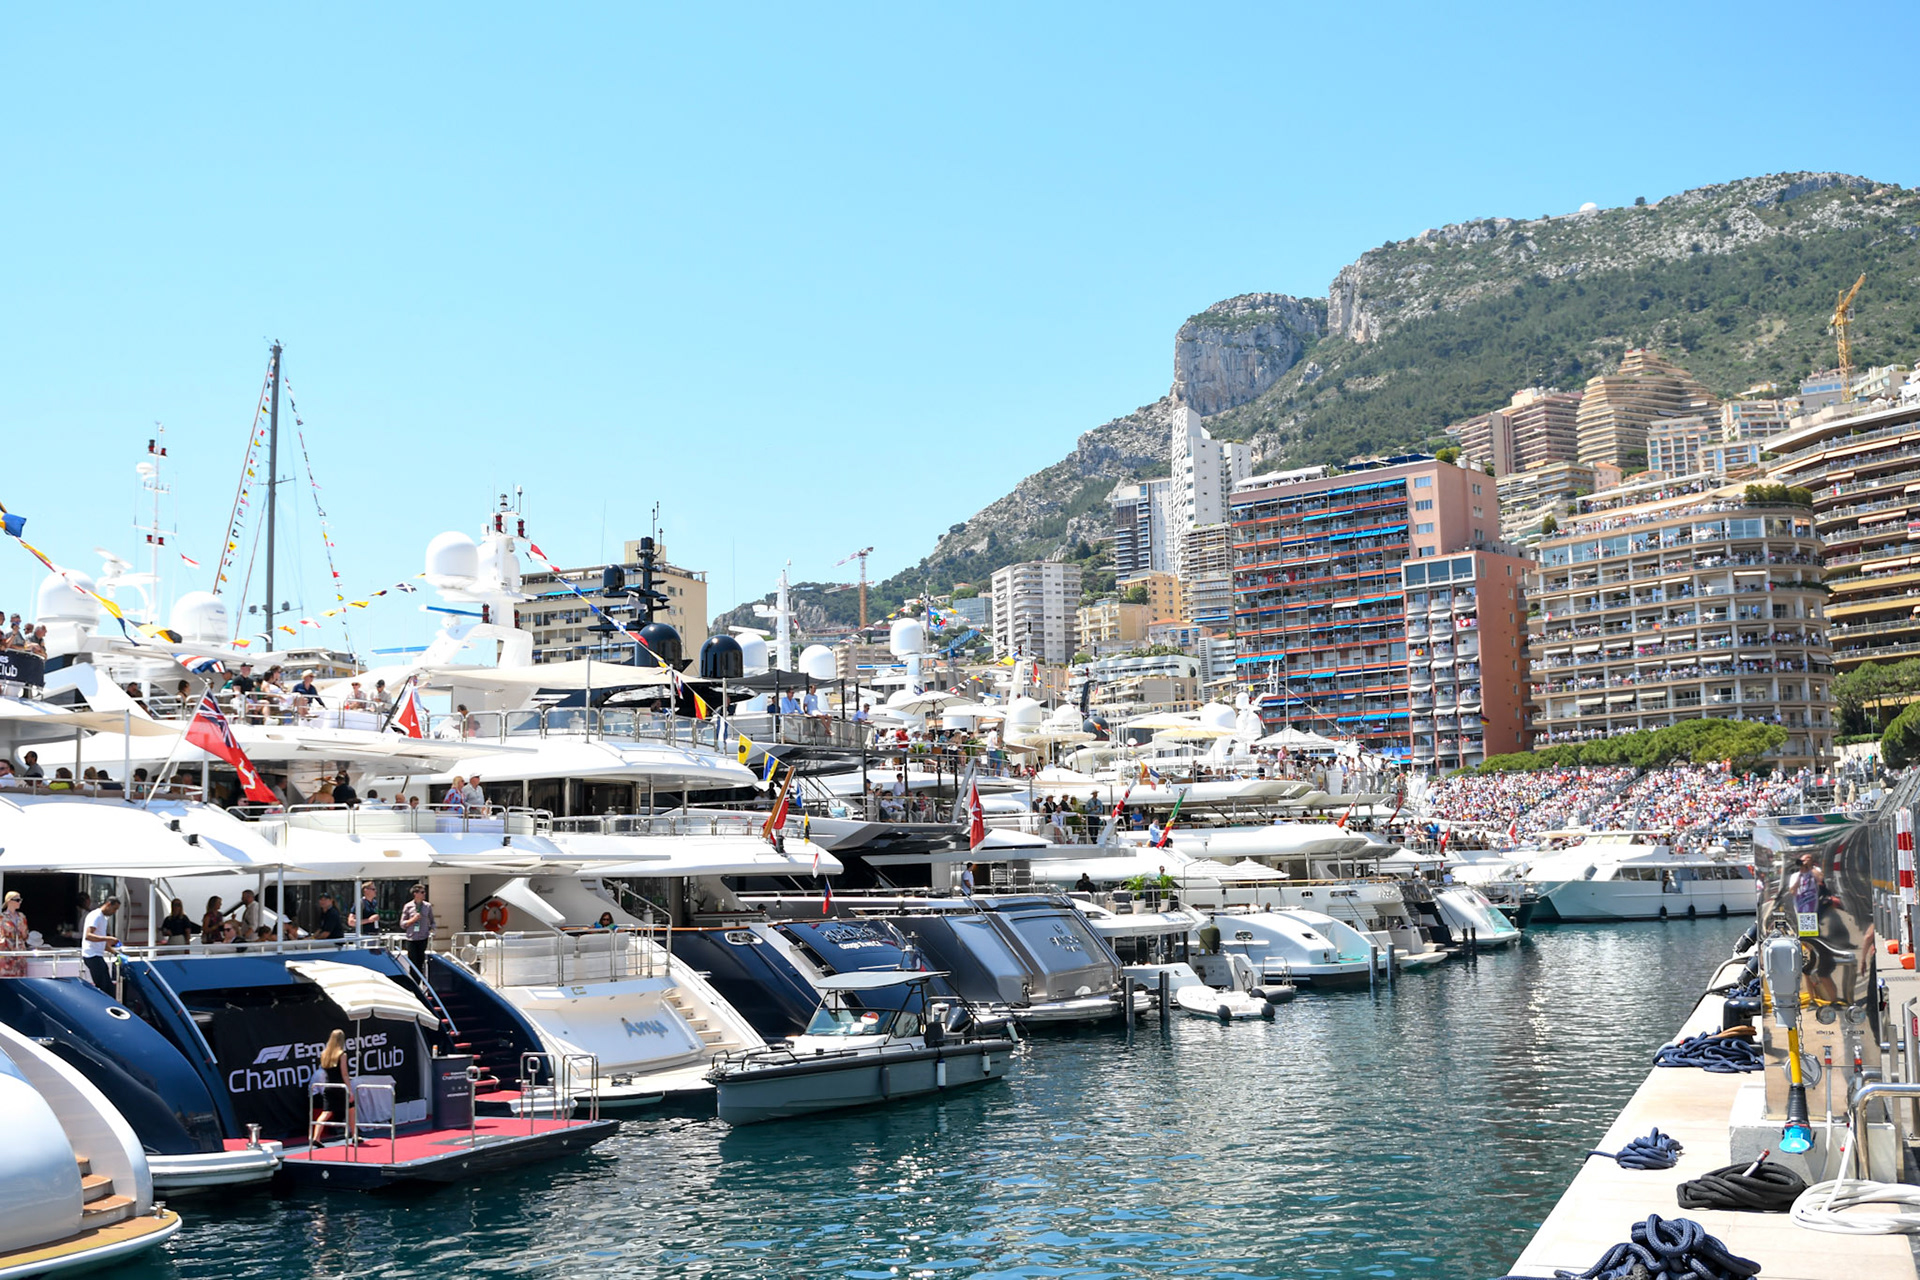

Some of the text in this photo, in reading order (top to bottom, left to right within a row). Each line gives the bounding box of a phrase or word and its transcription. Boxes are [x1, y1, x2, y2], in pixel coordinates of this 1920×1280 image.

[294, 1033, 387, 1058] Expences
[229, 1046, 404, 1093] Champis Club
